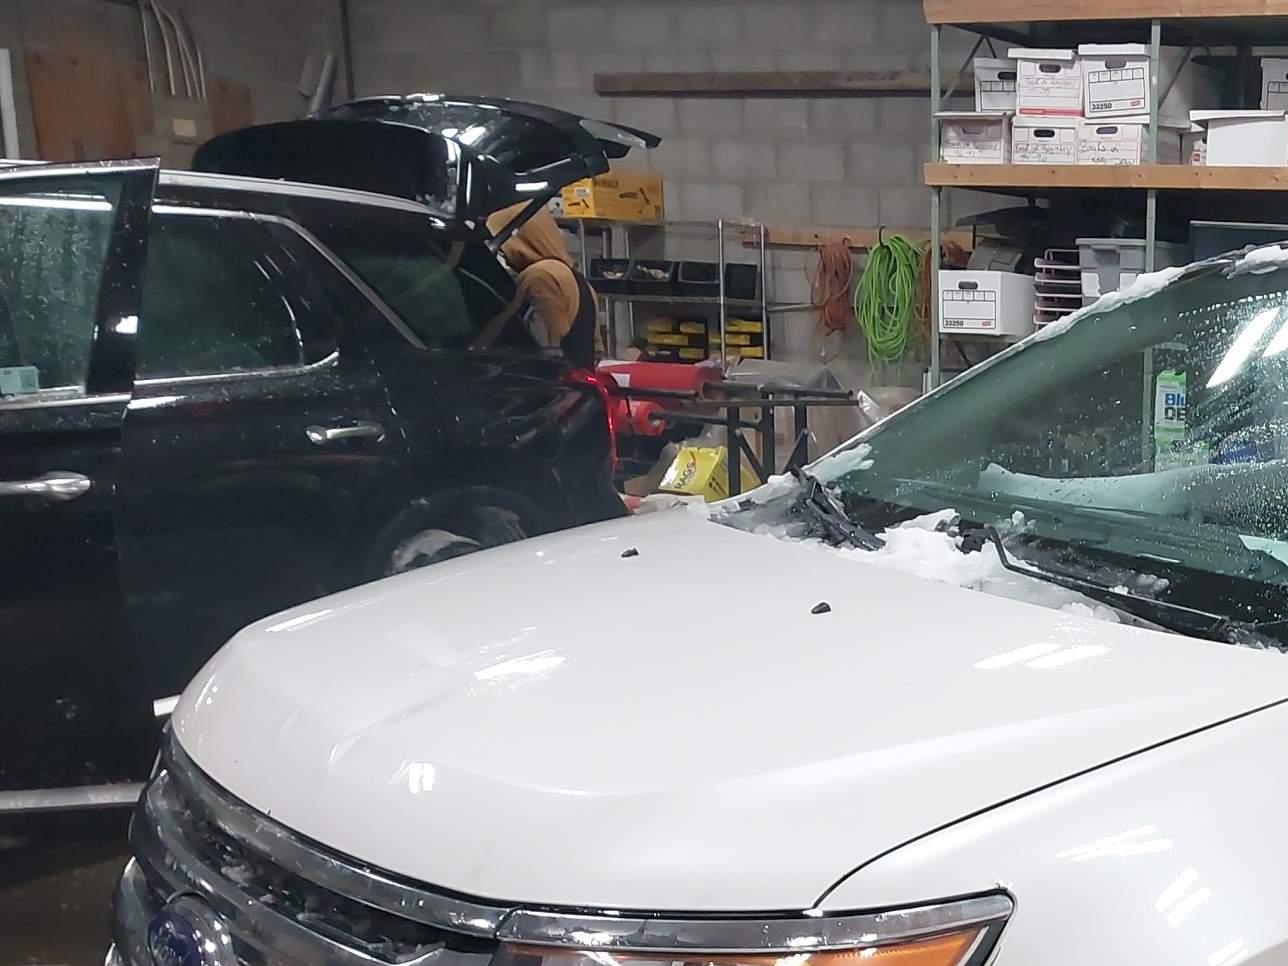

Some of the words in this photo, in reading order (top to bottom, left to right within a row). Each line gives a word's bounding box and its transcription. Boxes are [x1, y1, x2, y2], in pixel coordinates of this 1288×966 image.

[1091, 102, 1113, 110] 33250
[945, 319, 964, 327] 33250
[1164, 407, 1186, 421] DE
